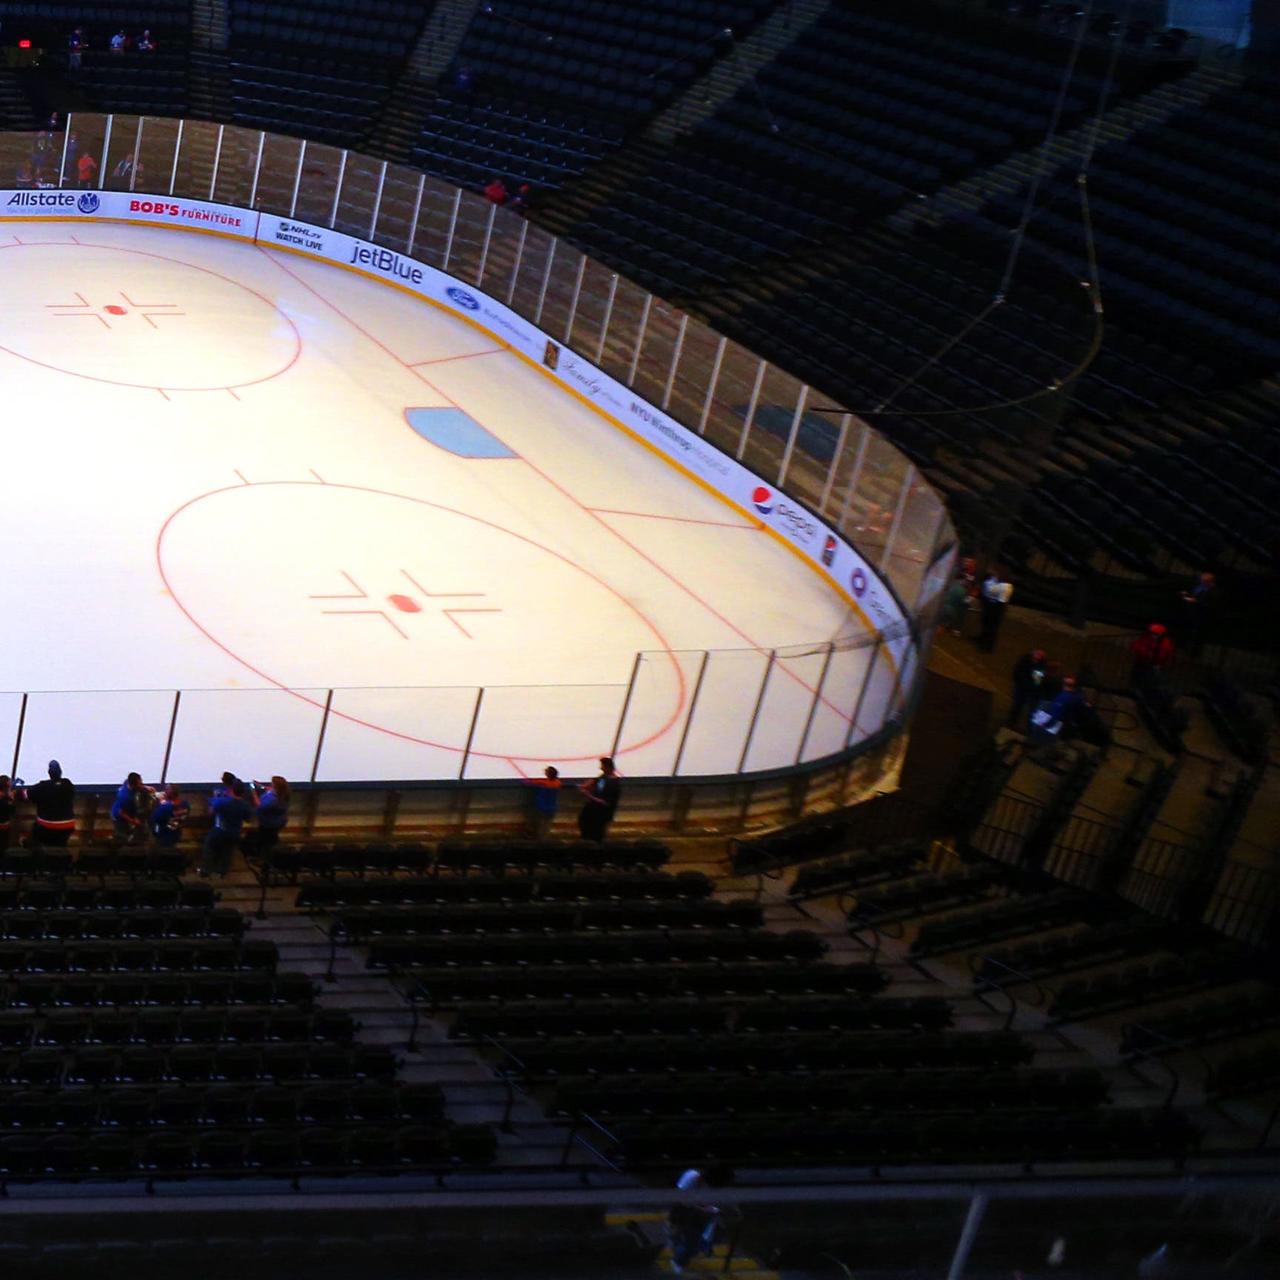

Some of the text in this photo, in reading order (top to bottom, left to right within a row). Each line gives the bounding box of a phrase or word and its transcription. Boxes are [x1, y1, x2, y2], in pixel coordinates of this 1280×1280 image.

[7, 193, 75, 206] Allstate
[130, 200, 179, 216] BOB'S
[181, 209, 241, 227] FURNITURE
[276, 232, 323, 251] WATCH LIVE
[350, 241, 423, 284] jetBlue
